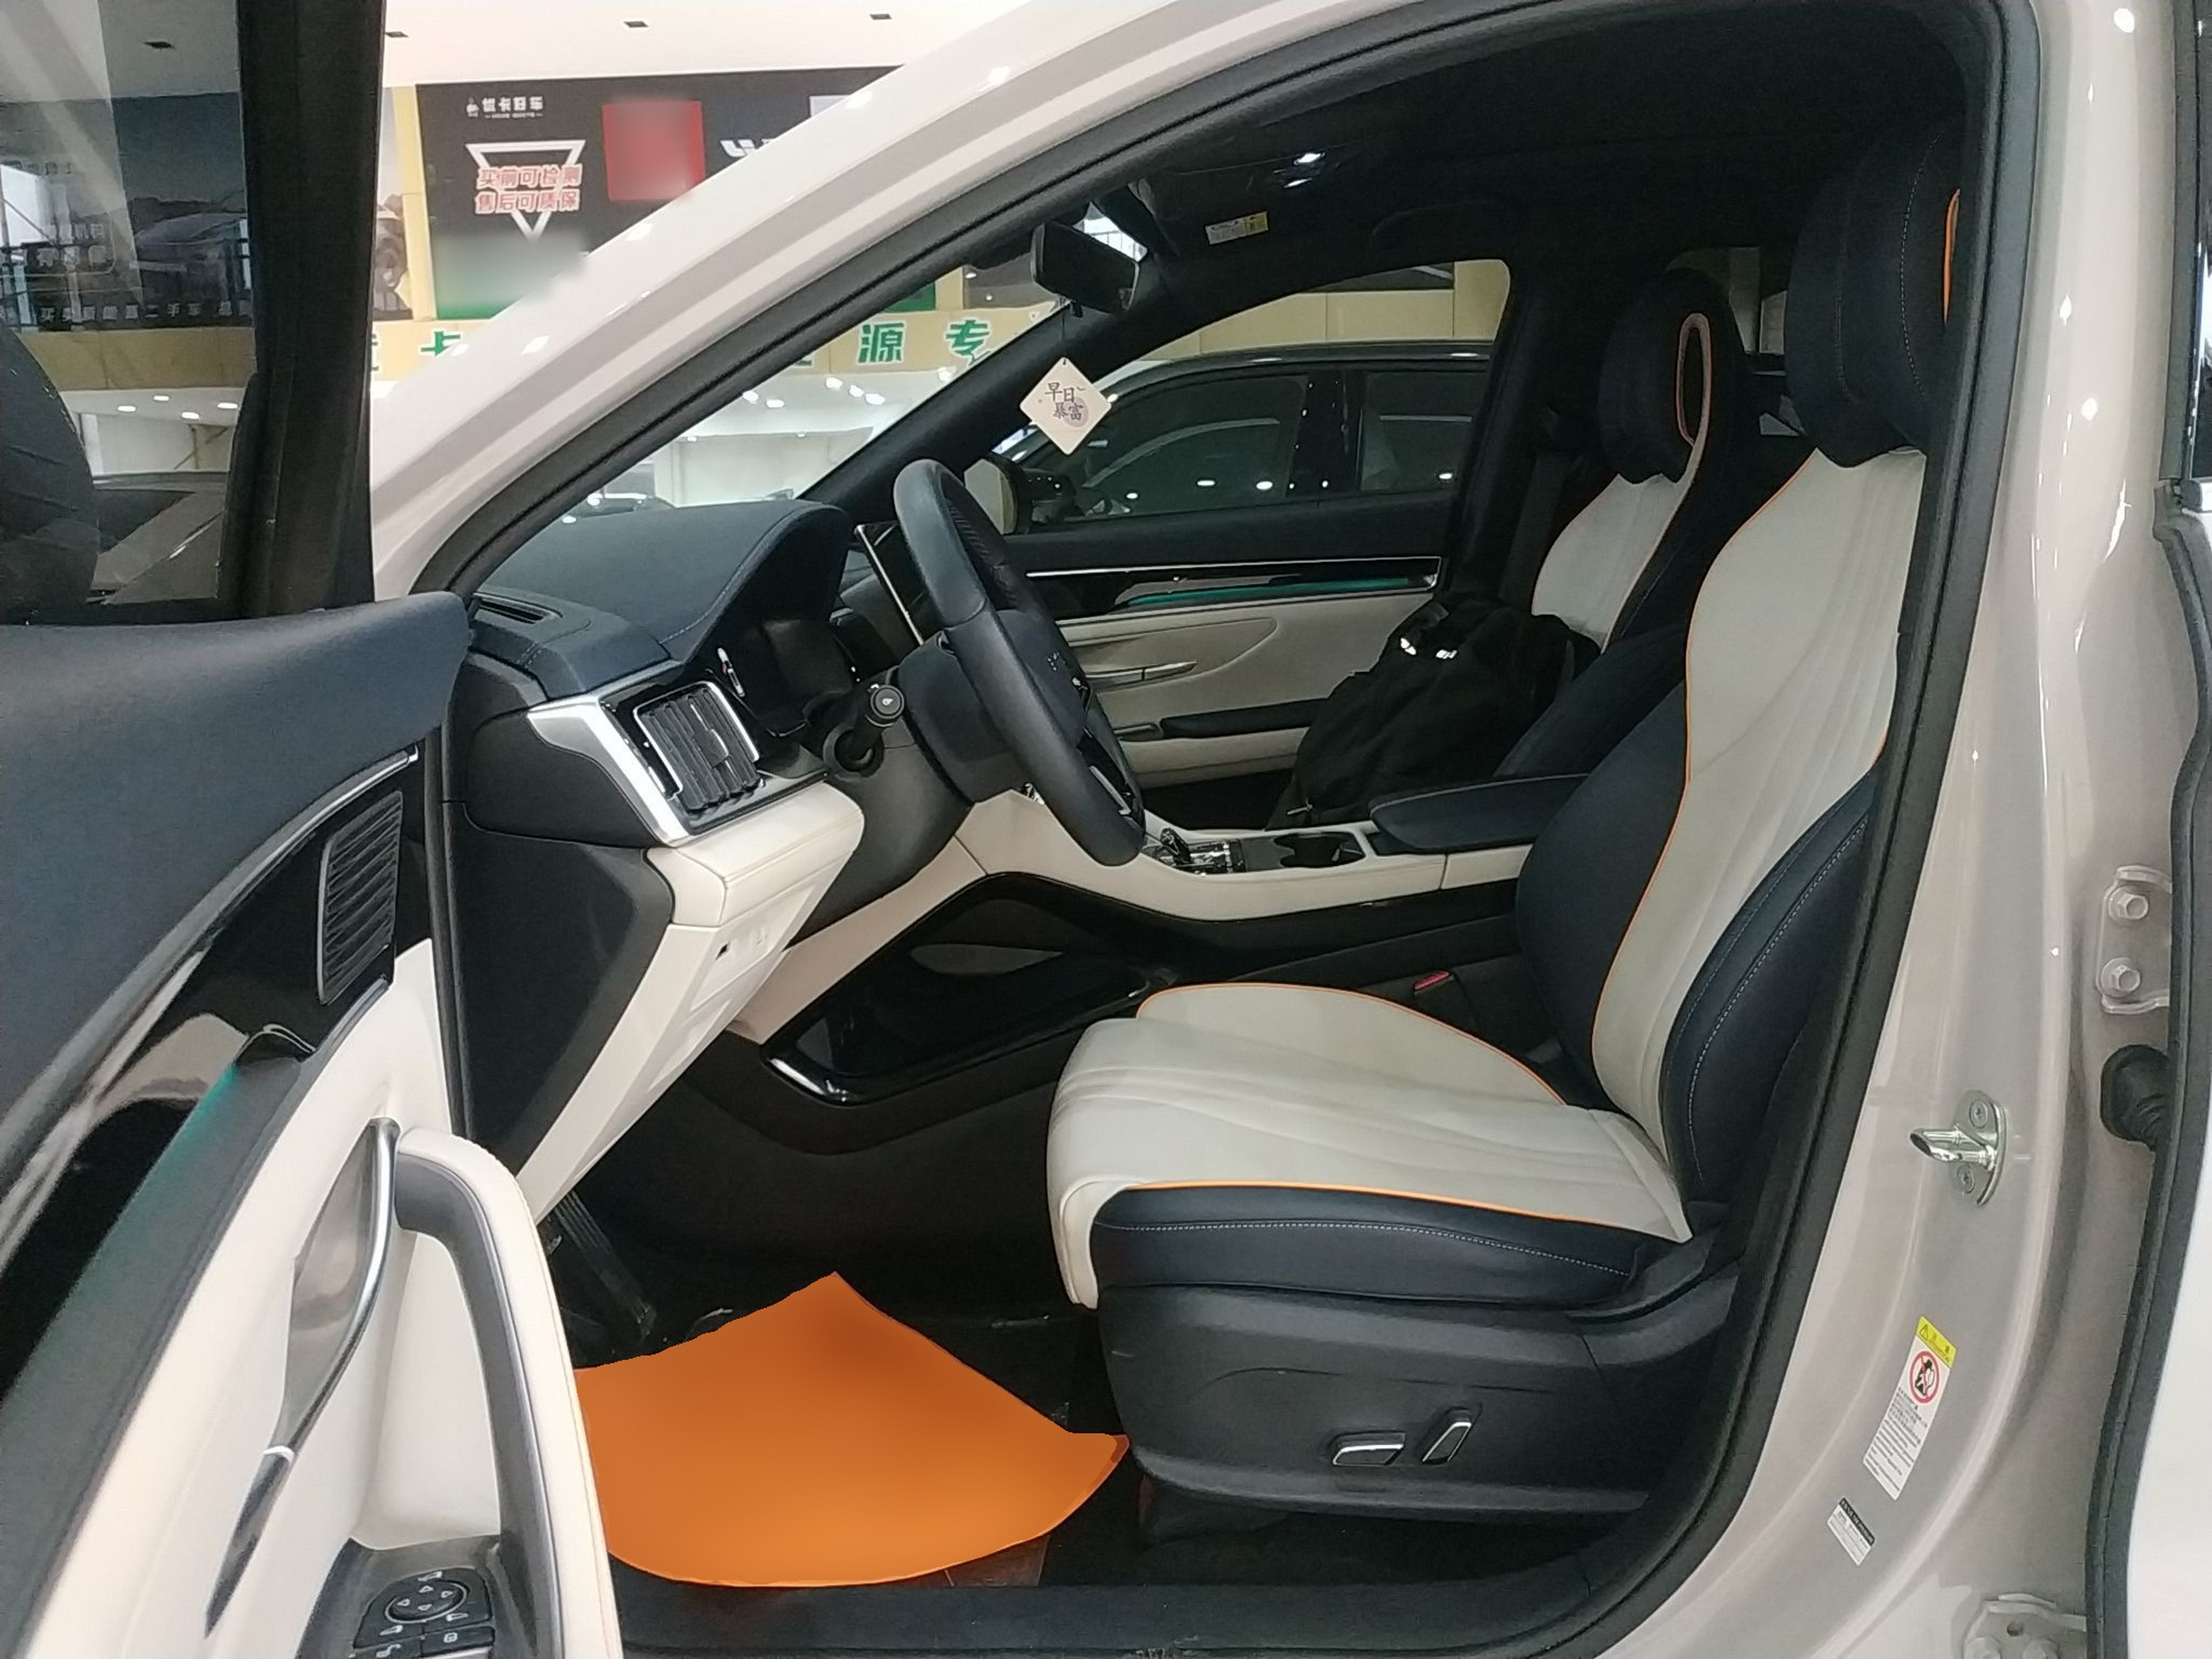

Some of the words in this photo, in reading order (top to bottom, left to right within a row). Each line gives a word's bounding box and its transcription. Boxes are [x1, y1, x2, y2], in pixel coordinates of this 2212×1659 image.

[475, 189, 579, 214] 售后可质保
[1044, 382, 1075, 403] 早日
[1052, 402, 1084, 421] 暴富
